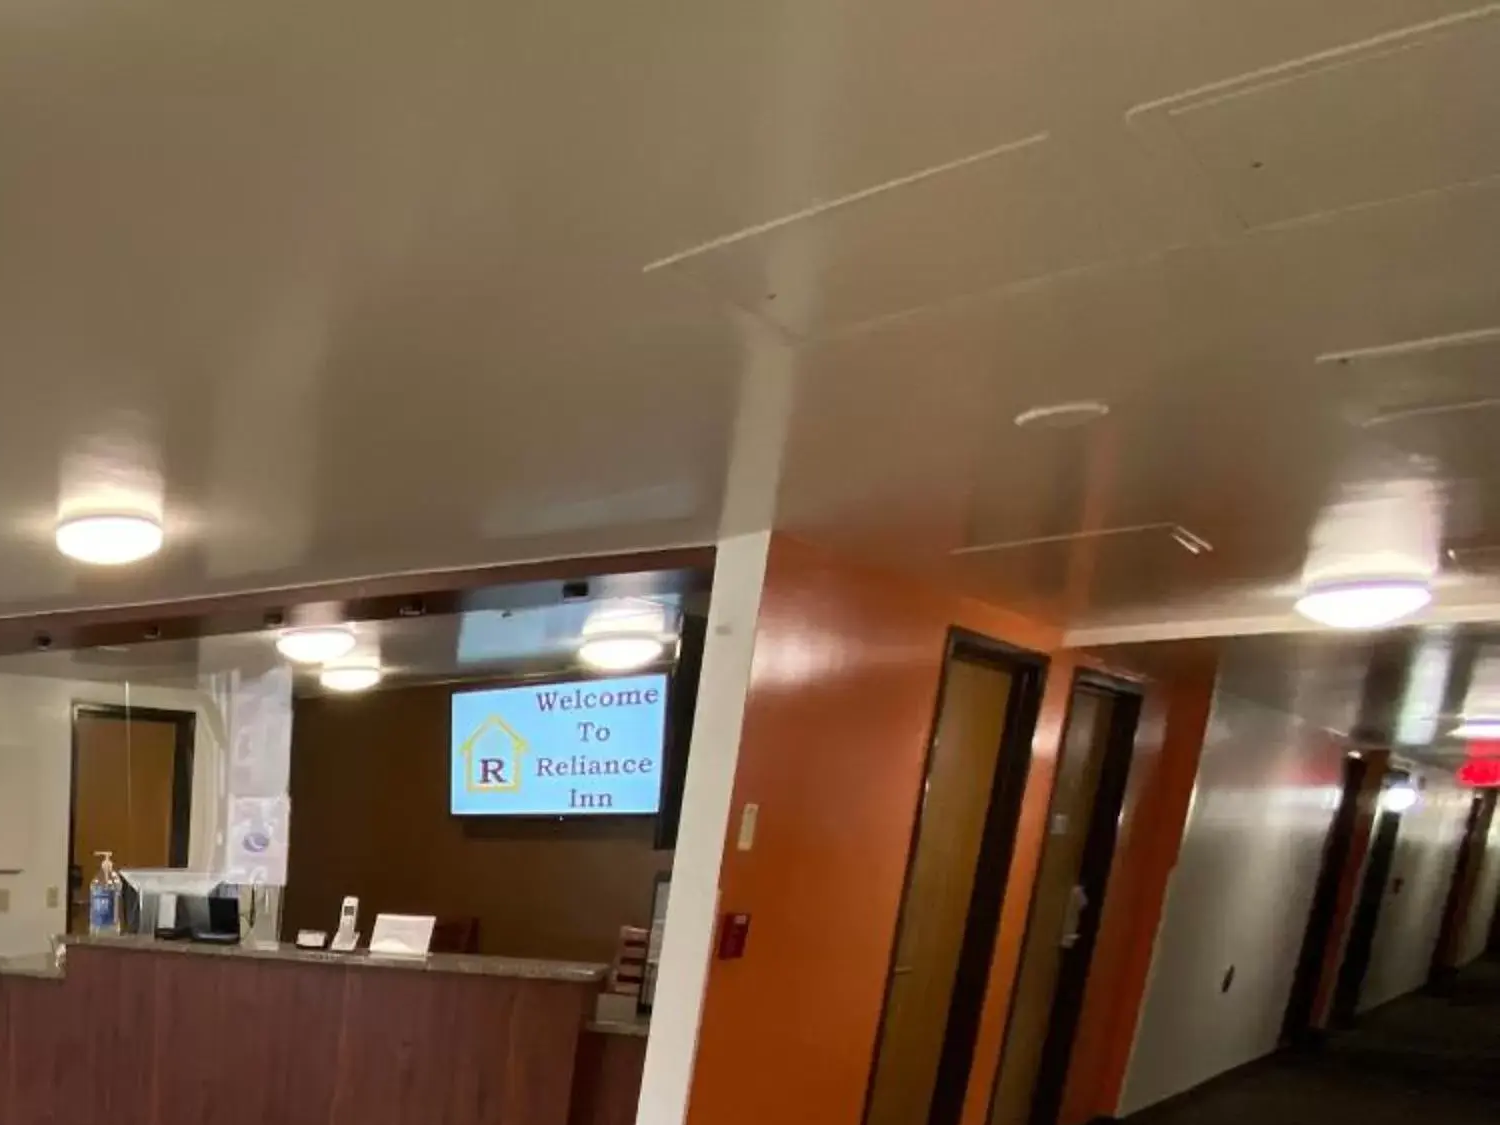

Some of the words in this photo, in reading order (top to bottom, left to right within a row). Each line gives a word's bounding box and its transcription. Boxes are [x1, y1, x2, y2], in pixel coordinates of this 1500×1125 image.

[536, 687, 659, 712] Welcome
[578, 722, 611, 742] To
[479, 758, 506, 784] R
[536, 756, 653, 777] Reliance
[569, 789, 613, 808] Inn
